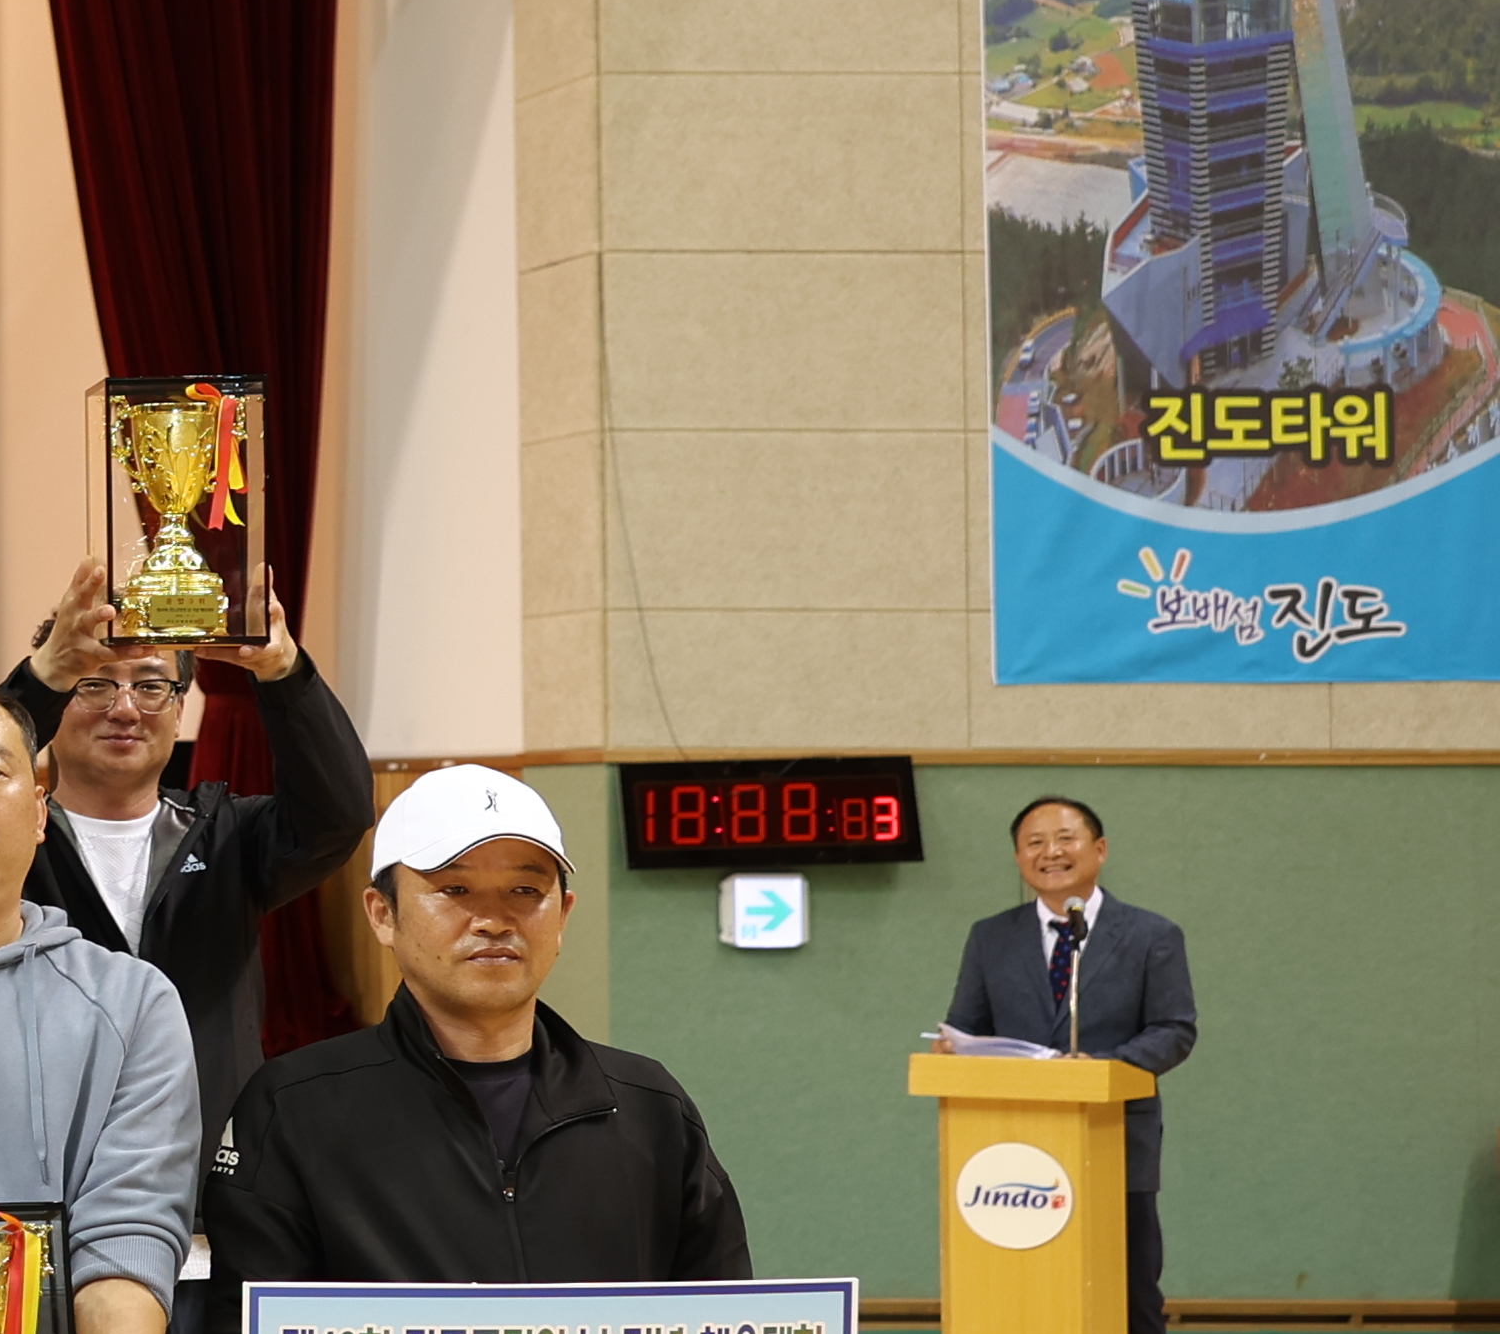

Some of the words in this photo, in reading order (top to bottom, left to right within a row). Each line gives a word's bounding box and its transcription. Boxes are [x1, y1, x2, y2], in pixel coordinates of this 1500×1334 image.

[1148, 391, 1390, 461] 진도타워
[1150, 587, 1263, 641] 보배섬
[1267, 580, 1405, 659] 진도
[964, 1182, 1050, 1210] Jindo
